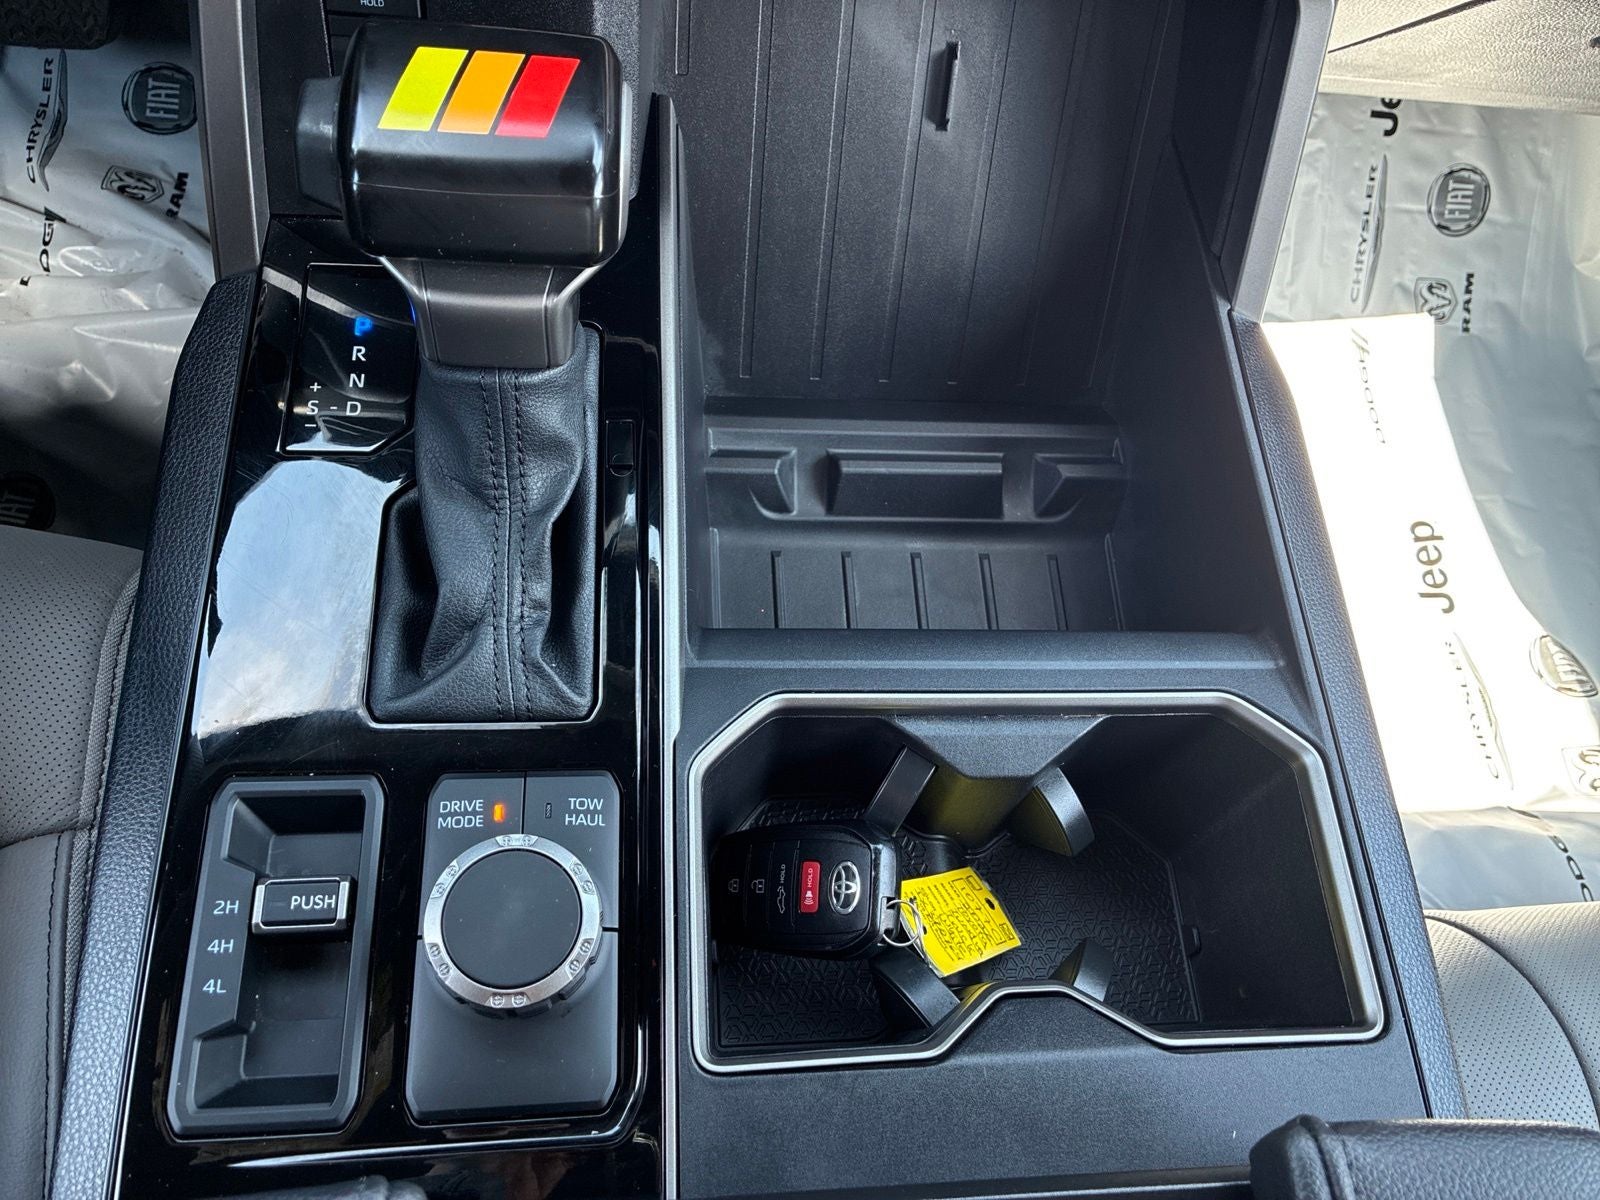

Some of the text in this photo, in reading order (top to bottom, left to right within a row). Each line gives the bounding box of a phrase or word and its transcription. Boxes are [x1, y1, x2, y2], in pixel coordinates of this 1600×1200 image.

[146, 77, 182, 120] FIAT
[26, 58, 54, 184] CHRYSLER
[1370, 97, 1402, 137] Je
[165, 171, 189, 218] RAM
[1444, 180, 1475, 219] FIAT
[1350, 164, 1378, 303] CHRYSLER
[1461, 272, 1475, 334] RAM
[354, 316, 373, 336] P
[352, 346, 366, 361] R
[349, 374, 366, 388] N
[306, 400, 362, 416] S D
[1410, 521, 1455, 614] Jeep
[439, 800, 484, 813] DRIVE
[568, 798, 604, 810] TOW
[437, 816, 484, 829] MODE
[565, 814, 606, 826] HAUL
[213, 900, 239, 915] 2H
[290, 894, 336, 910] PUSH
[207, 938, 234, 954] 4H
[202, 978, 227, 994] 4L
